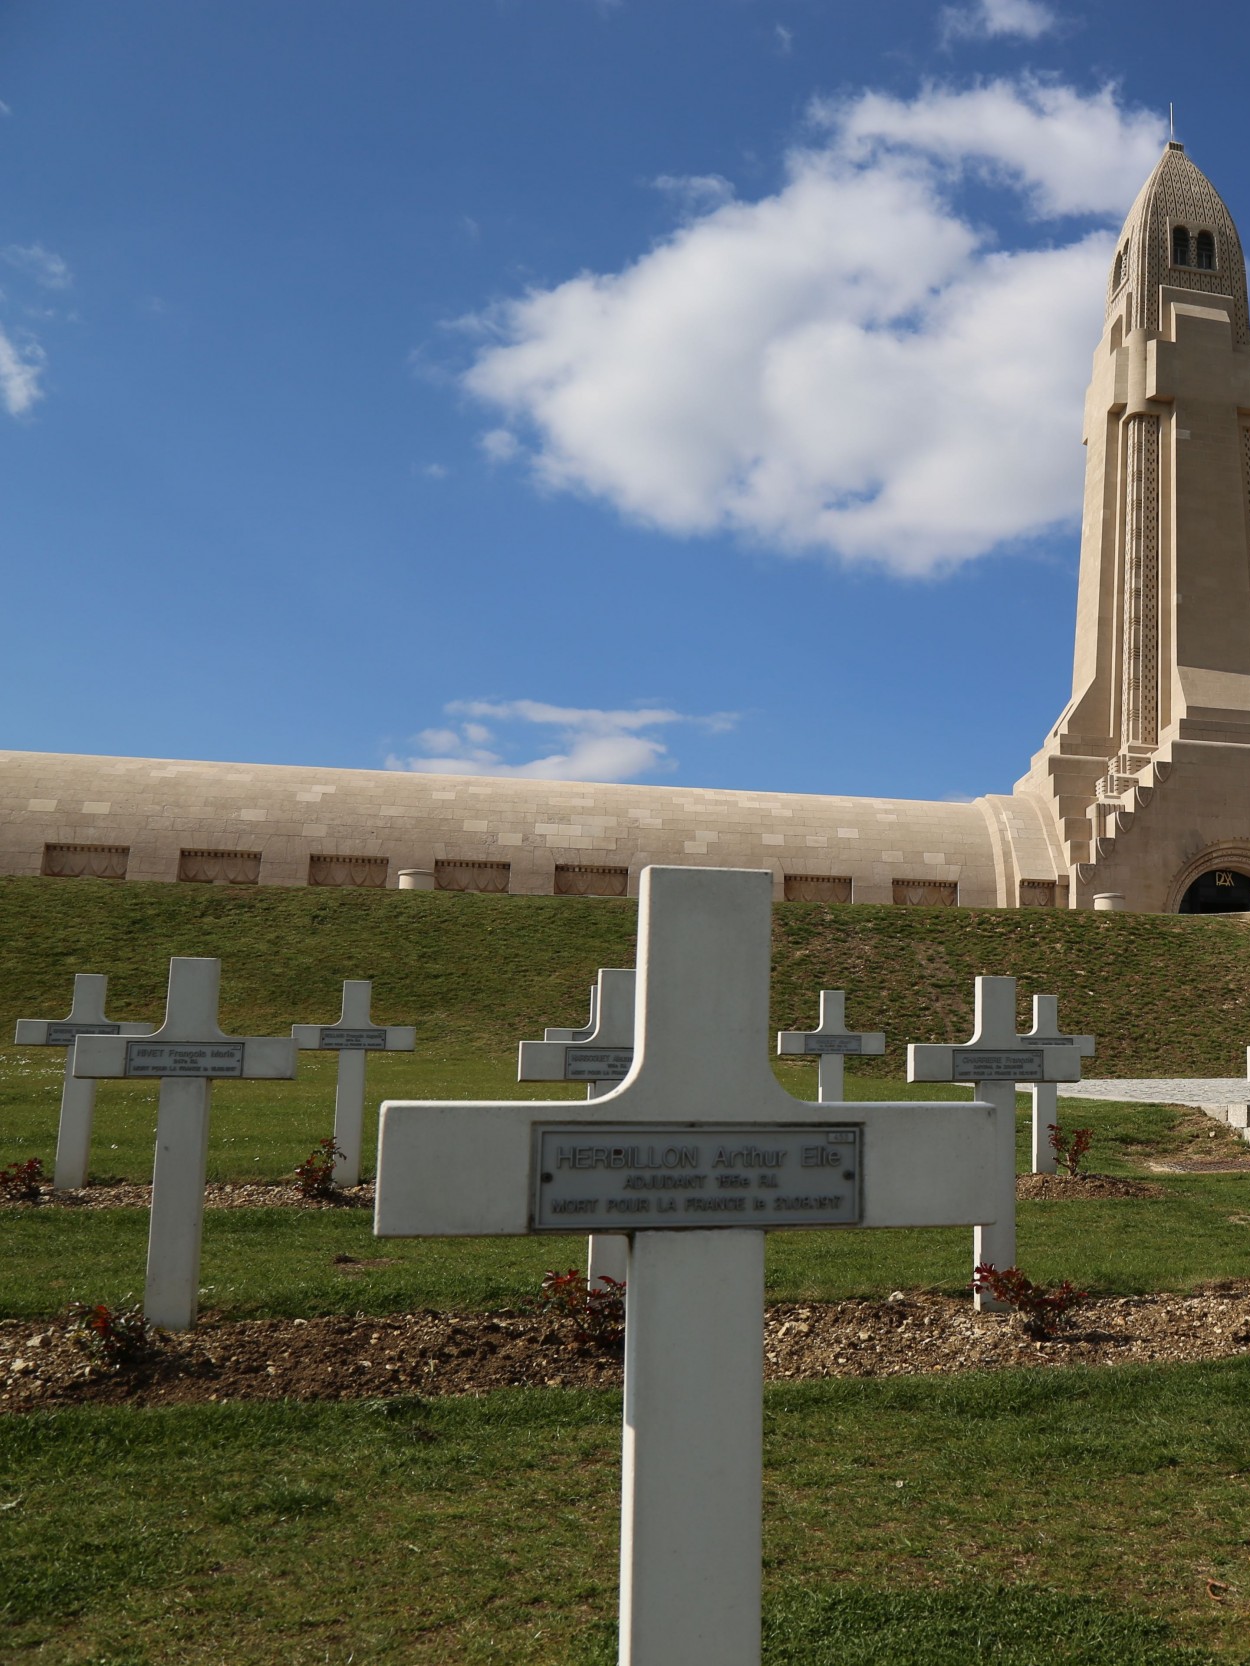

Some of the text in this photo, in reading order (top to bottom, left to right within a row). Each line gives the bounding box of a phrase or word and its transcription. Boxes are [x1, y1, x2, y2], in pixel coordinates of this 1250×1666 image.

[1216, 872, 1234, 886] PAX
[556, 1145, 842, 1169] HERBILLON Arthur Elie
[623, 1174, 707, 1190] ADJUDANT
[715, 1174, 750, 1189] 155e
[551, 1199, 599, 1214] MORT
[606, 1198, 650, 1213] POUR
[656, 1198, 676, 1212] LA
[684, 1196, 746, 1212] FRANCE
[752, 1196, 766, 1211] le
